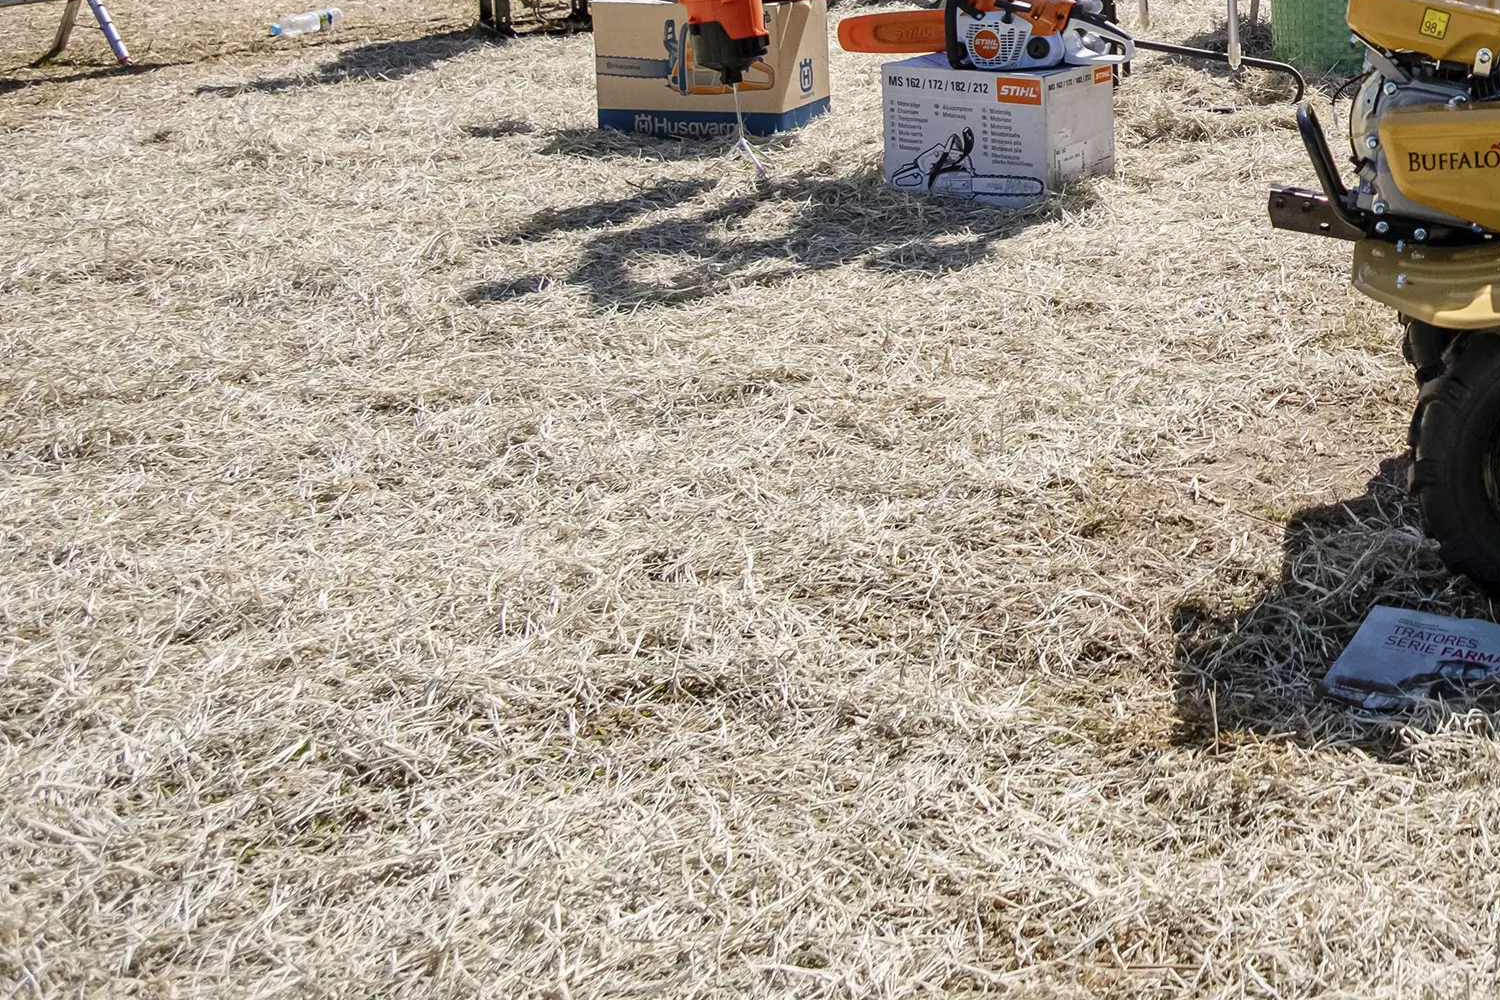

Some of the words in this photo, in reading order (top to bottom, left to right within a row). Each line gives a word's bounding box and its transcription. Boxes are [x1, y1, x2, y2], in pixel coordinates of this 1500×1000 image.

[1424, 20, 1438, 34] 98
[975, 38, 998, 46] STIHL
[888, 76, 903, 87] MS
[906, 78, 920, 89] 162
[929, 79, 943, 90] 172
[951, 81, 965, 92] 182
[973, 83, 989, 94] 212
[1000, 85, 1038, 98] STIHL
[1408, 150, 1500, 171] BUFFALO
[1394, 625, 1479, 649] TRATORES
